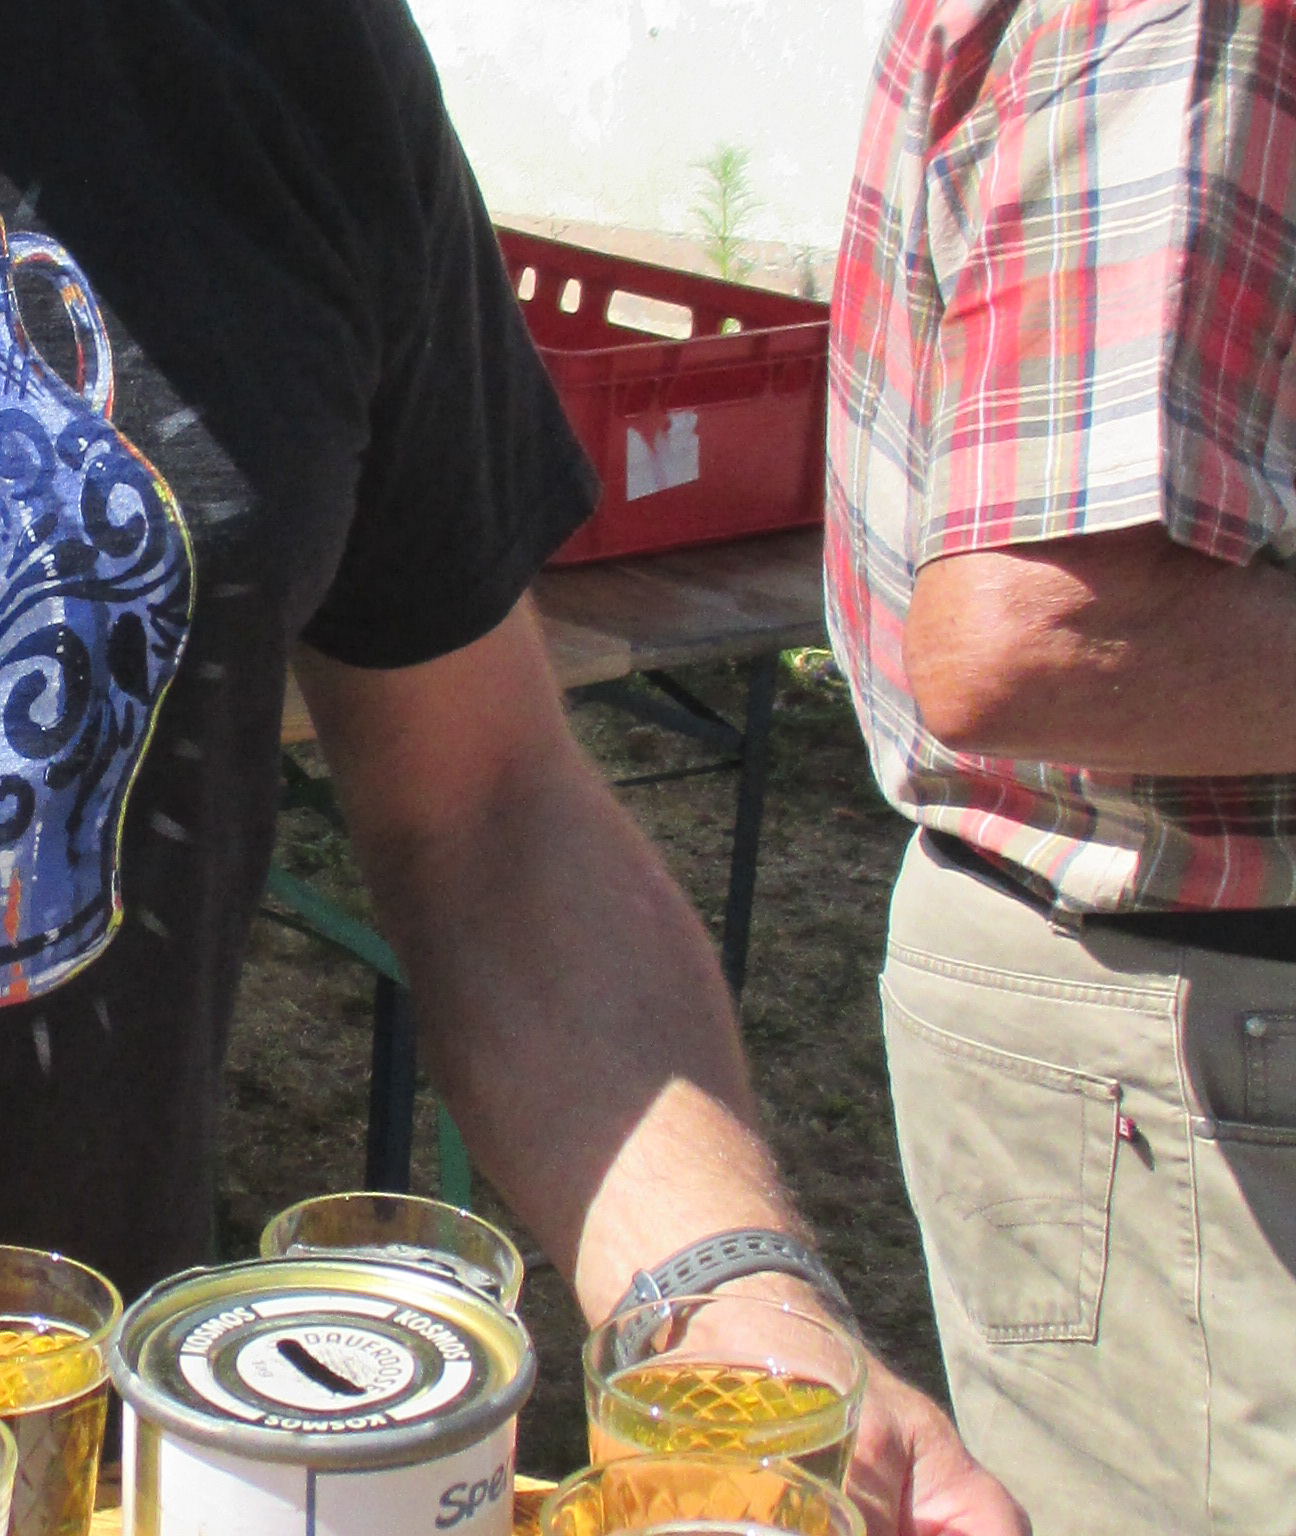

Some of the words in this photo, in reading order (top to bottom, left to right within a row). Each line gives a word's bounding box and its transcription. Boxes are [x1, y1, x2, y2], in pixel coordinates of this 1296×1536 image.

[181, 1306, 256, 1354] KOSMOS
[393, 1308, 472, 1360] KOSMOS
[304, 1332, 403, 1393] DAUERDOSE
[264, 1411, 388, 1432] KOSMOS
[435, 1461, 507, 1529] Spe
